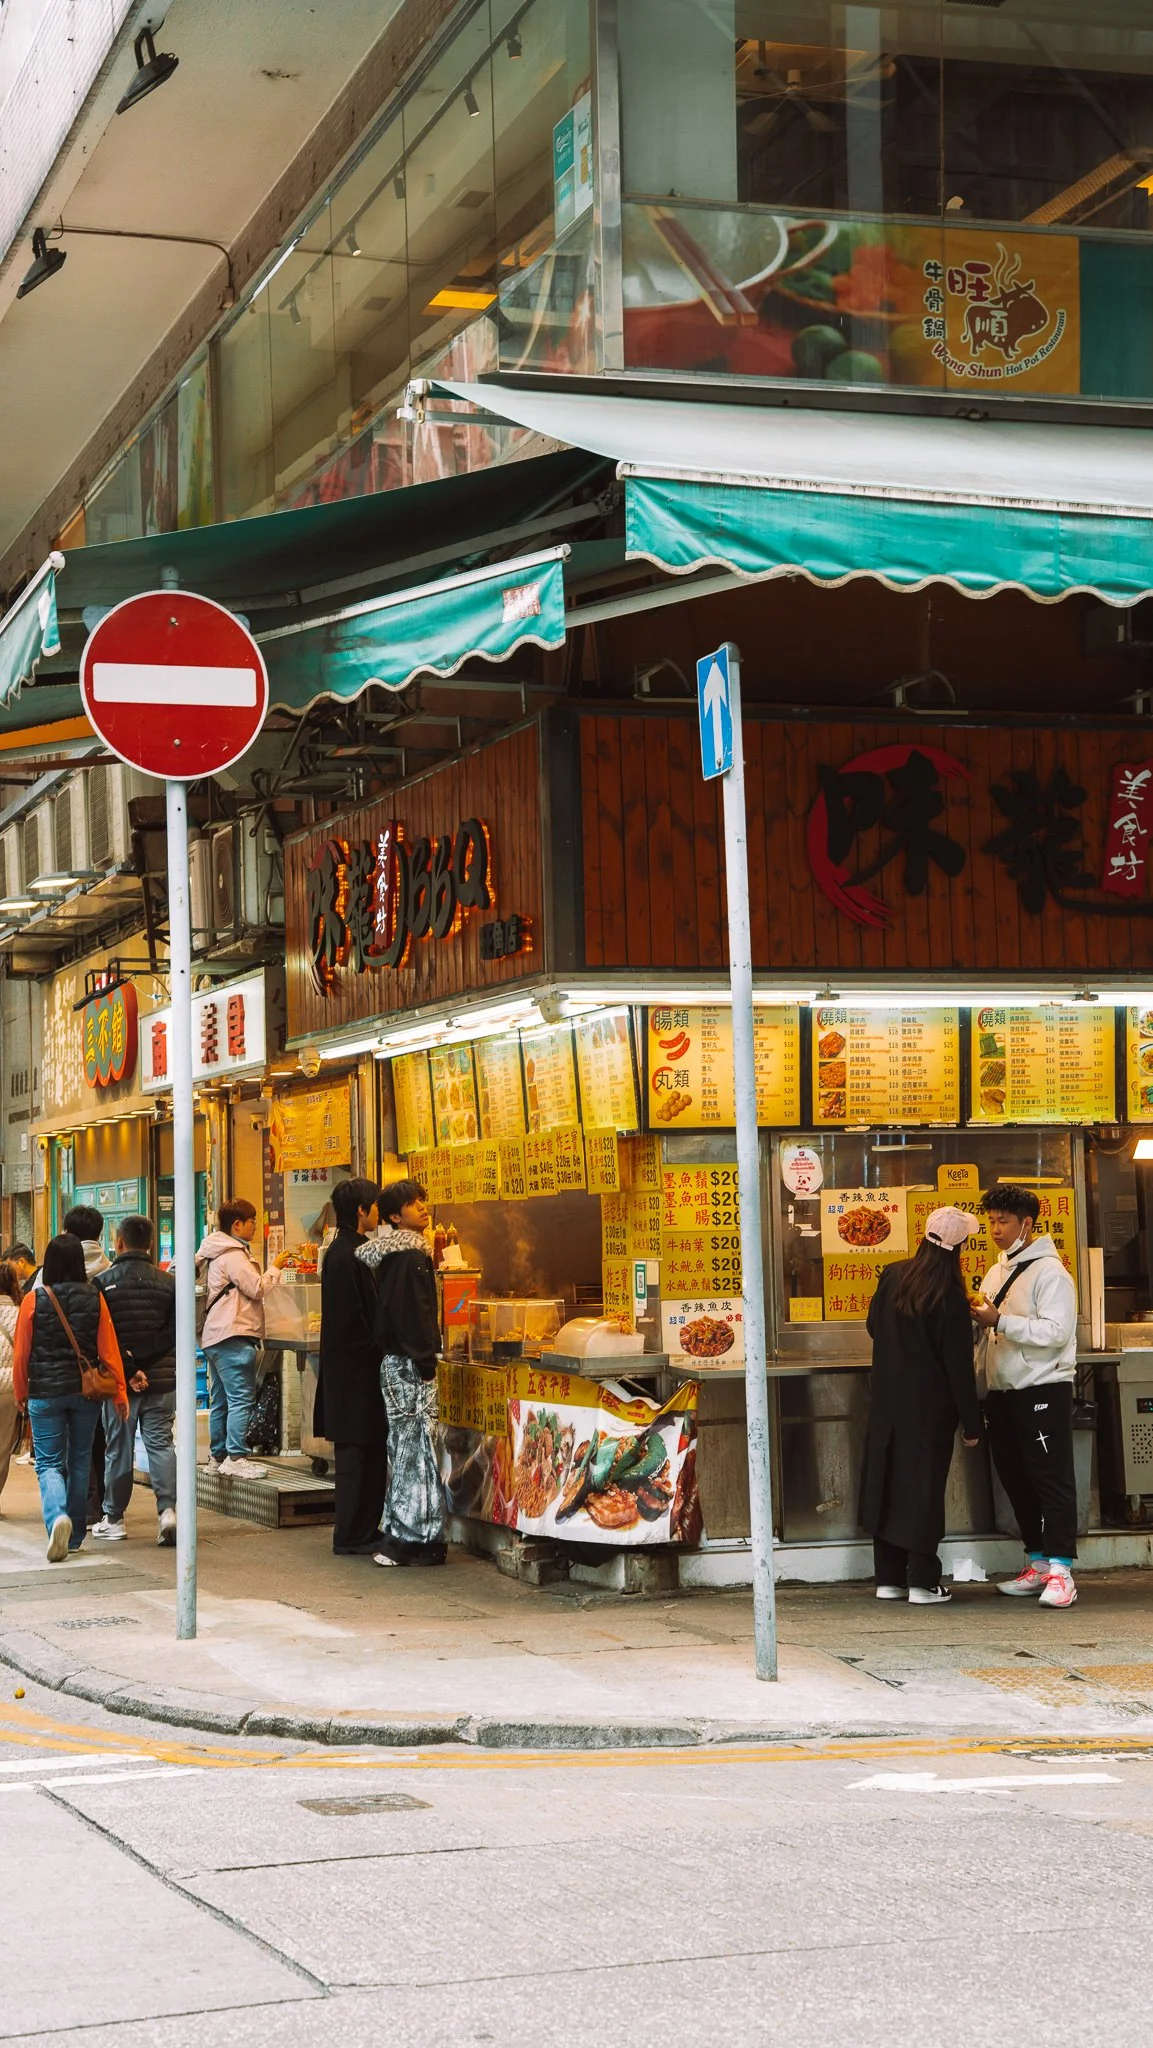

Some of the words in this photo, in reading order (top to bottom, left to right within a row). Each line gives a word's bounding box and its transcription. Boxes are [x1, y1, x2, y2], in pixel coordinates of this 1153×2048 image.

[923, 261, 946, 339] 牛骨鍋
[932, 343, 966, 376] Wong
[967, 363, 1003, 379] Shun
[1004, 362, 1023, 377] Hot
[1023, 354, 1040, 369] Pot
[1039, 310, 1067, 359] Restaurant
[1108, 769, 1153, 882] 美食坊
[374, 829, 391, 935] 美食坊
[653, 1008, 690, 1031] 腸類
[888, 1028, 899, 1036] $18
[655, 1069, 690, 1090] 丸類
[603, 1136, 614, 1150] $20
[604, 1155, 615, 1168] $20
[605, 1171, 616, 1185] $20
[646, 1169, 657, 1182] $20
[663, 1170, 709, 1189] 墨魚鬚
[947, 1168, 969, 1181] KeeTa
[511, 1178, 525, 1195] $20
[649, 1196, 660, 1211] $20
[663, 1191, 711, 1209] 墨魚咀
[839, 1192, 890, 1202] 香辣魚皮
[649, 1218, 660, 1232] $20
[663, 1210, 679, 1227] 生
[694, 1209, 711, 1226] 腸
[649, 1237, 661, 1251] $25
[666, 1237, 705, 1253] 牛柏葉
[710, 1236, 740, 1250] $20
[667, 1258, 706, 1274] 水魷魚
[711, 1257, 740, 1272] $20
[827, 1263, 874, 1281] 狗仔粉
[665, 1277, 712, 1292] 水魷魚鬚
[712, 1277, 741, 1291] $25
[680, 1301, 733, 1313] 香辣魚皮
[472, 1407, 484, 1425] $20
